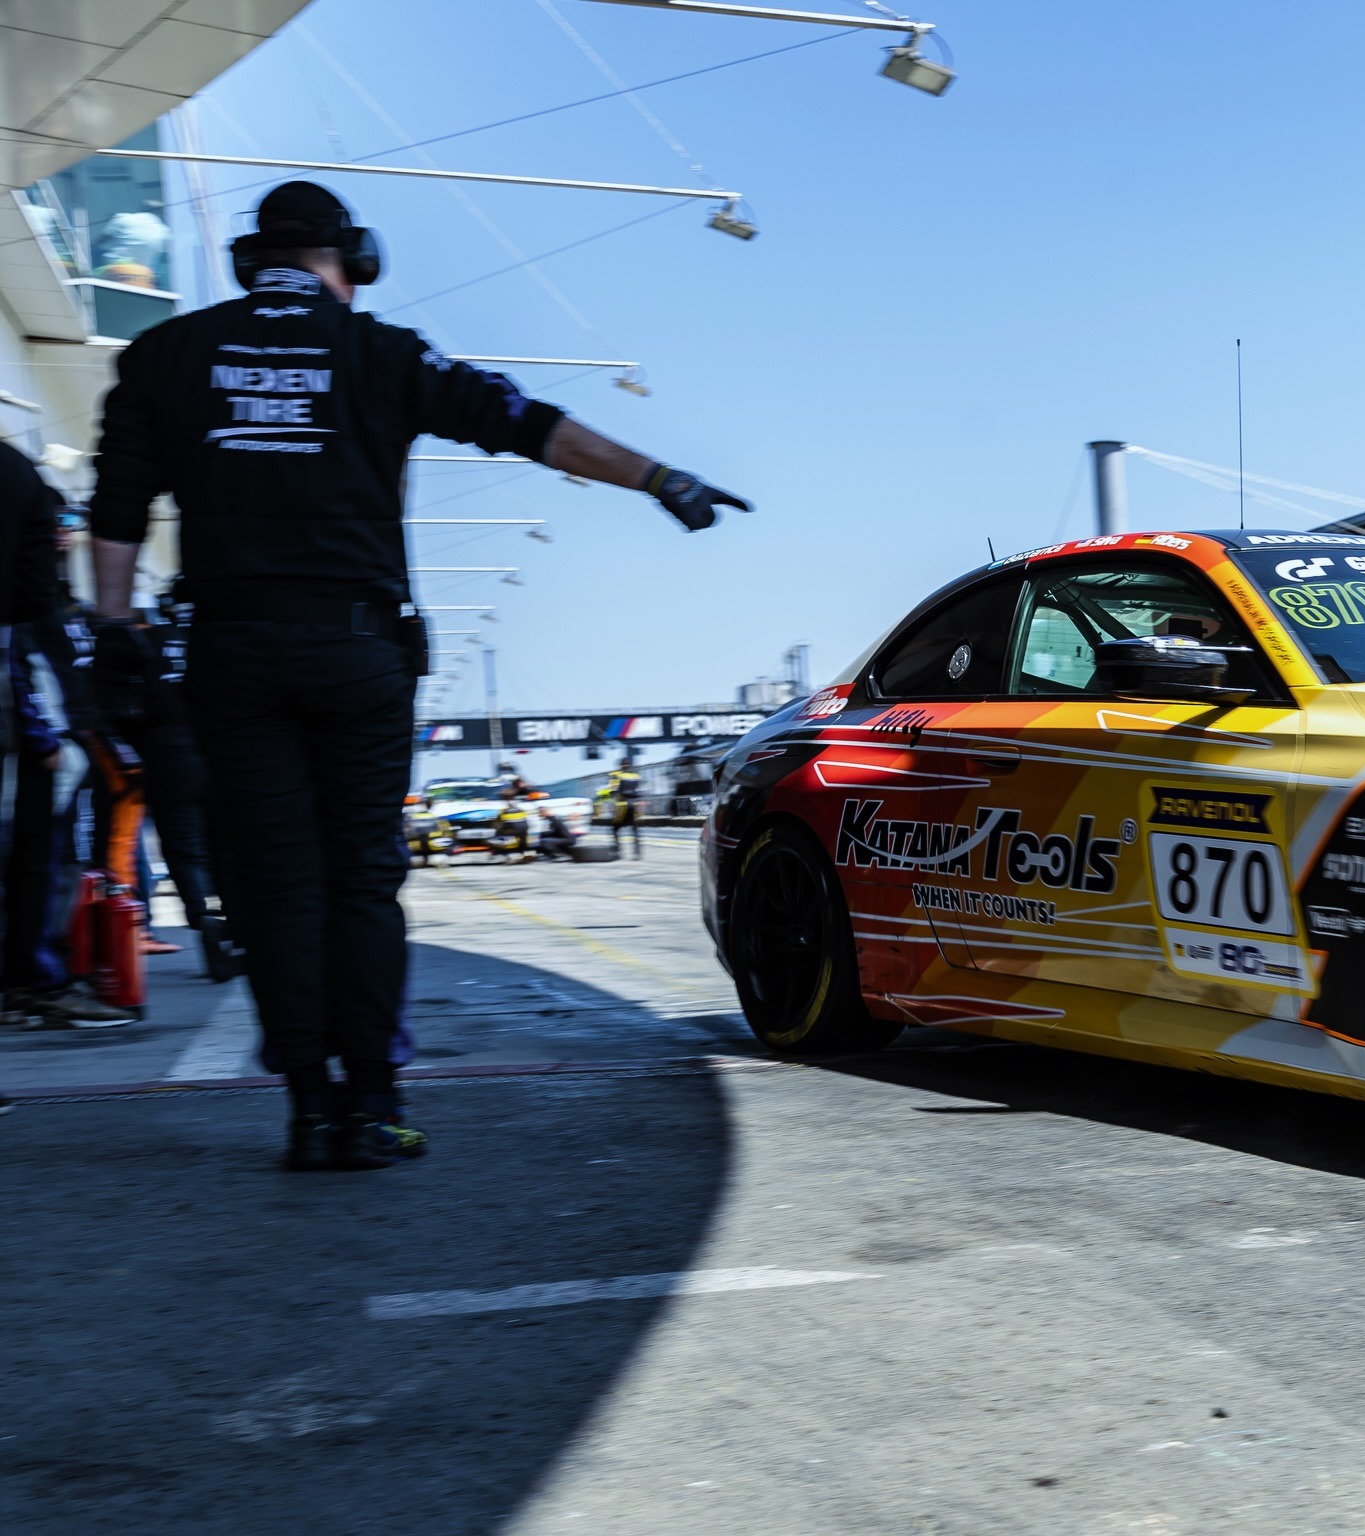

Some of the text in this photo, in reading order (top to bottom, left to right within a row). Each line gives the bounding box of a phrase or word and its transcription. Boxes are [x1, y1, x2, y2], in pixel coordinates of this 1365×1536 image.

[210, 365, 333, 392] NEXEN
[226, 397, 313, 423] TIRE
[516, 719, 592, 741] BMW
[870, 710, 934, 747] Hifly
[1160, 797, 1260, 823] RAVENOL
[1168, 842, 1274, 925] 870
[912, 884, 1056, 926] WHEN IT COUNTS!
